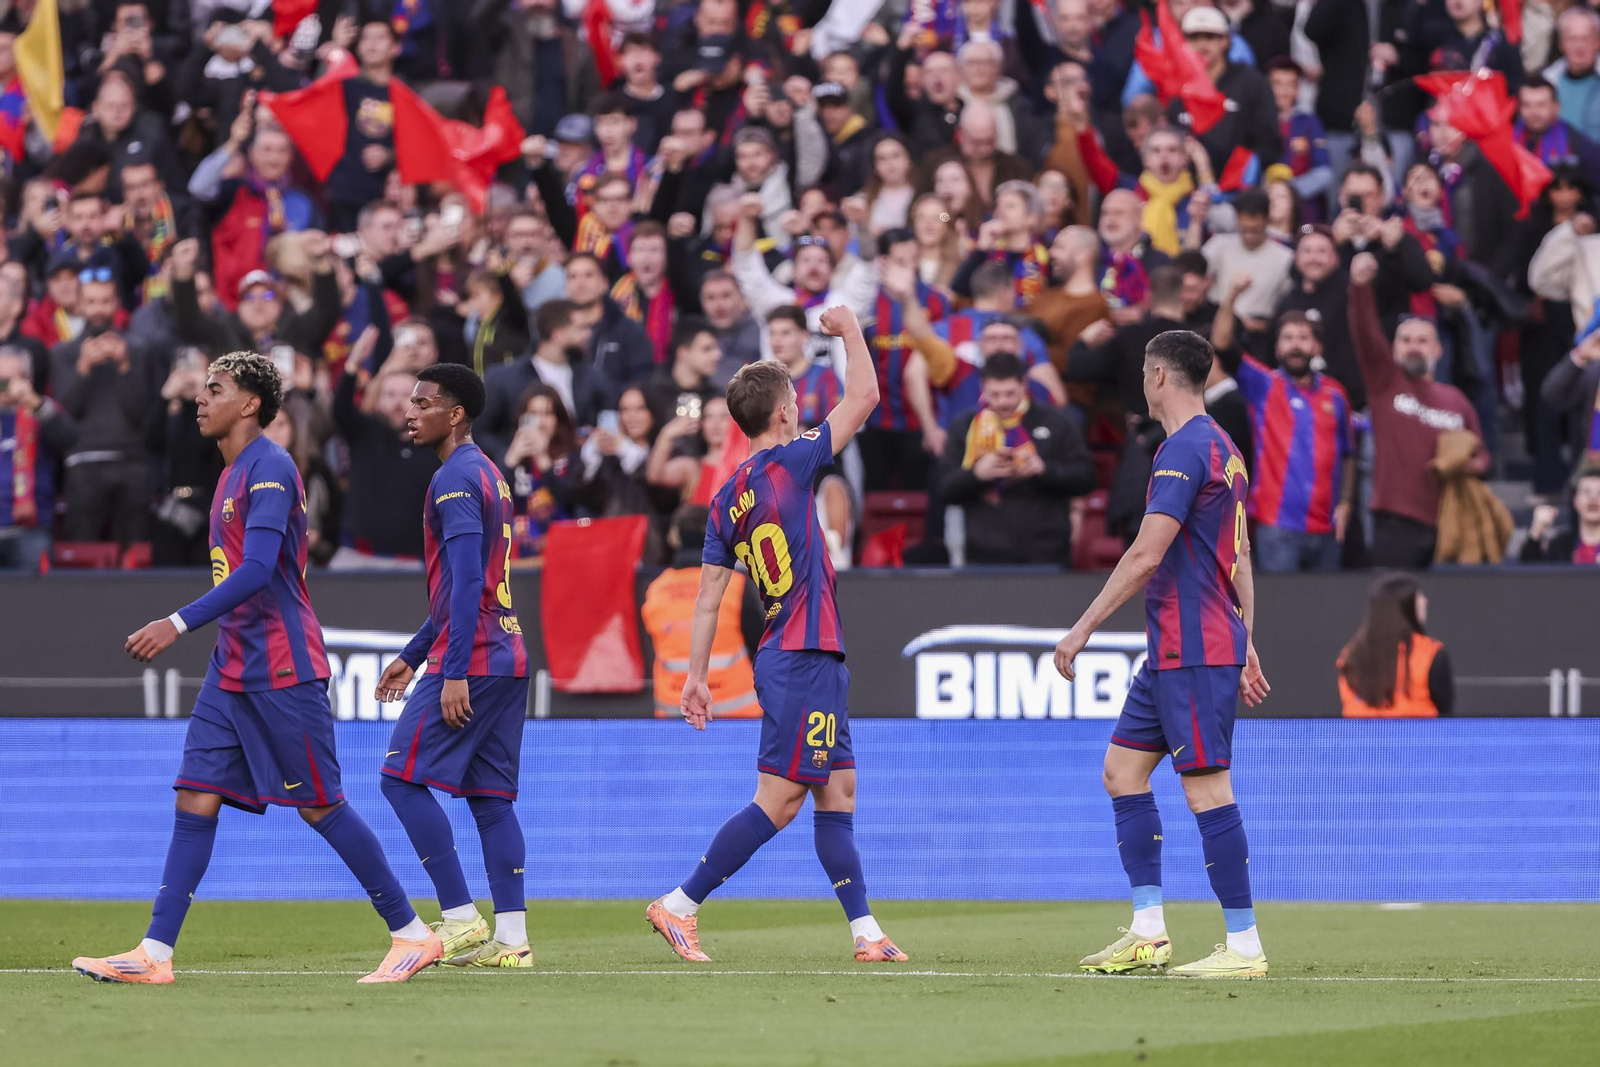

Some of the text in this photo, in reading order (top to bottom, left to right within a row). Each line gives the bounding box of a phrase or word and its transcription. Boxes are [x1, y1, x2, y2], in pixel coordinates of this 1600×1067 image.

[435, 491, 464, 505] AMBILIGHT
[915, 652, 1147, 720] BIMB
[806, 711, 836, 748] 20
